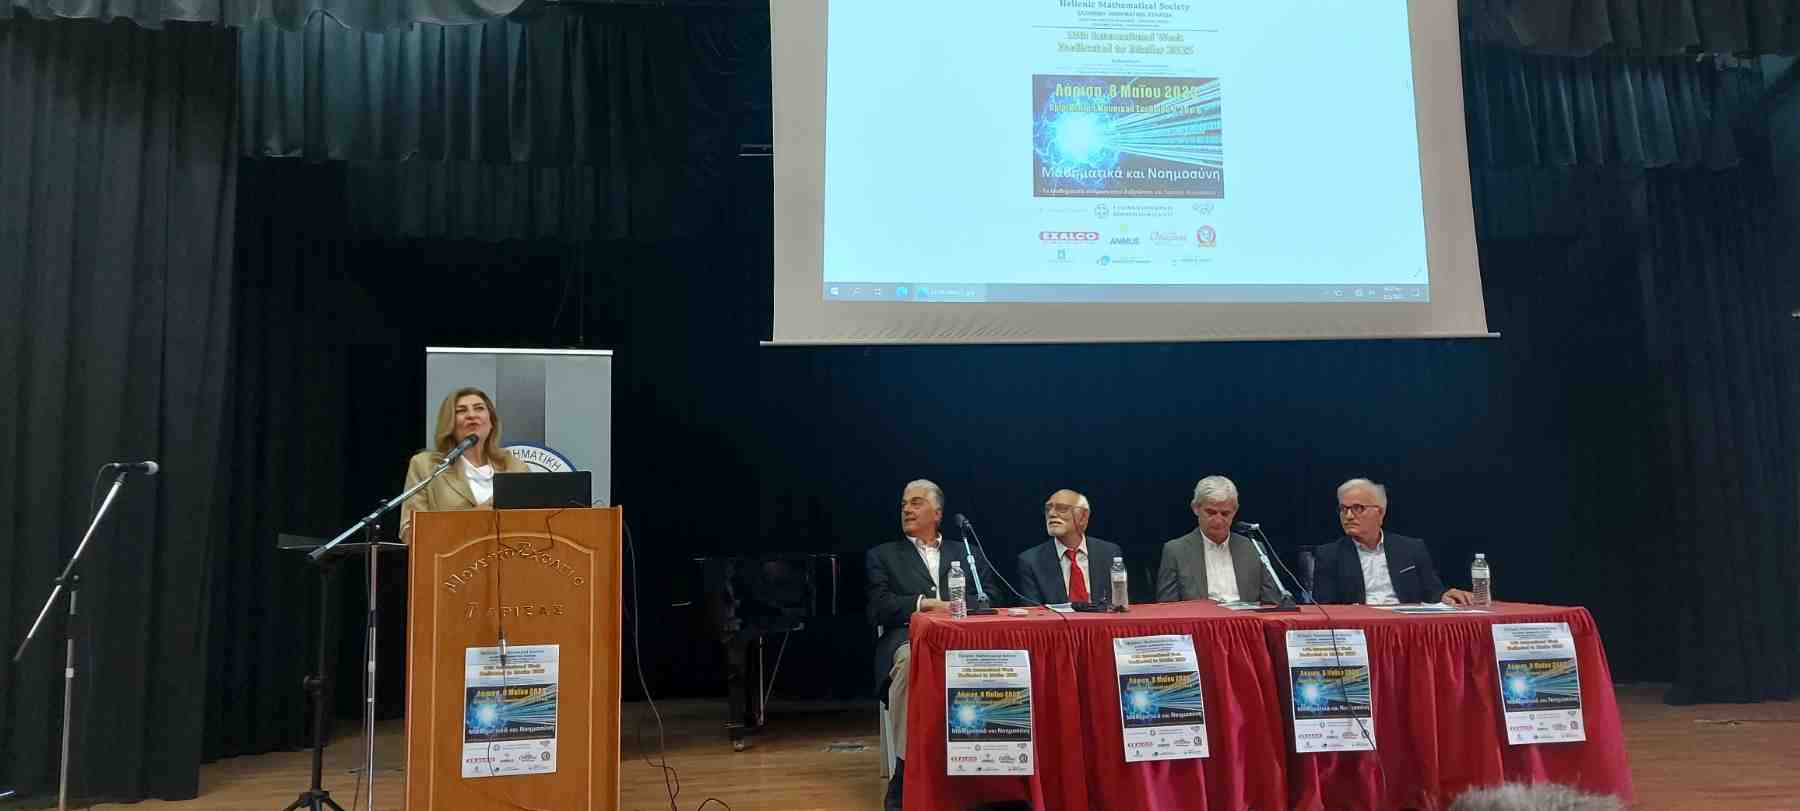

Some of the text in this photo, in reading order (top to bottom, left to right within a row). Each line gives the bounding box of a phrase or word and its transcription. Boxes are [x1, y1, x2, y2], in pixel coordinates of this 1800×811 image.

[1099, 0, 1157, 11] Mathematical
[1159, 2, 1191, 13] Society
[1109, 84, 1118, 98] 8
[1041, 166, 1221, 181] Μαθηματικά και Νοημοσύνη
[1041, 232, 1097, 242] EXALCO
[511, 448, 562, 472] ΗΜΑΤΙΚΗ
